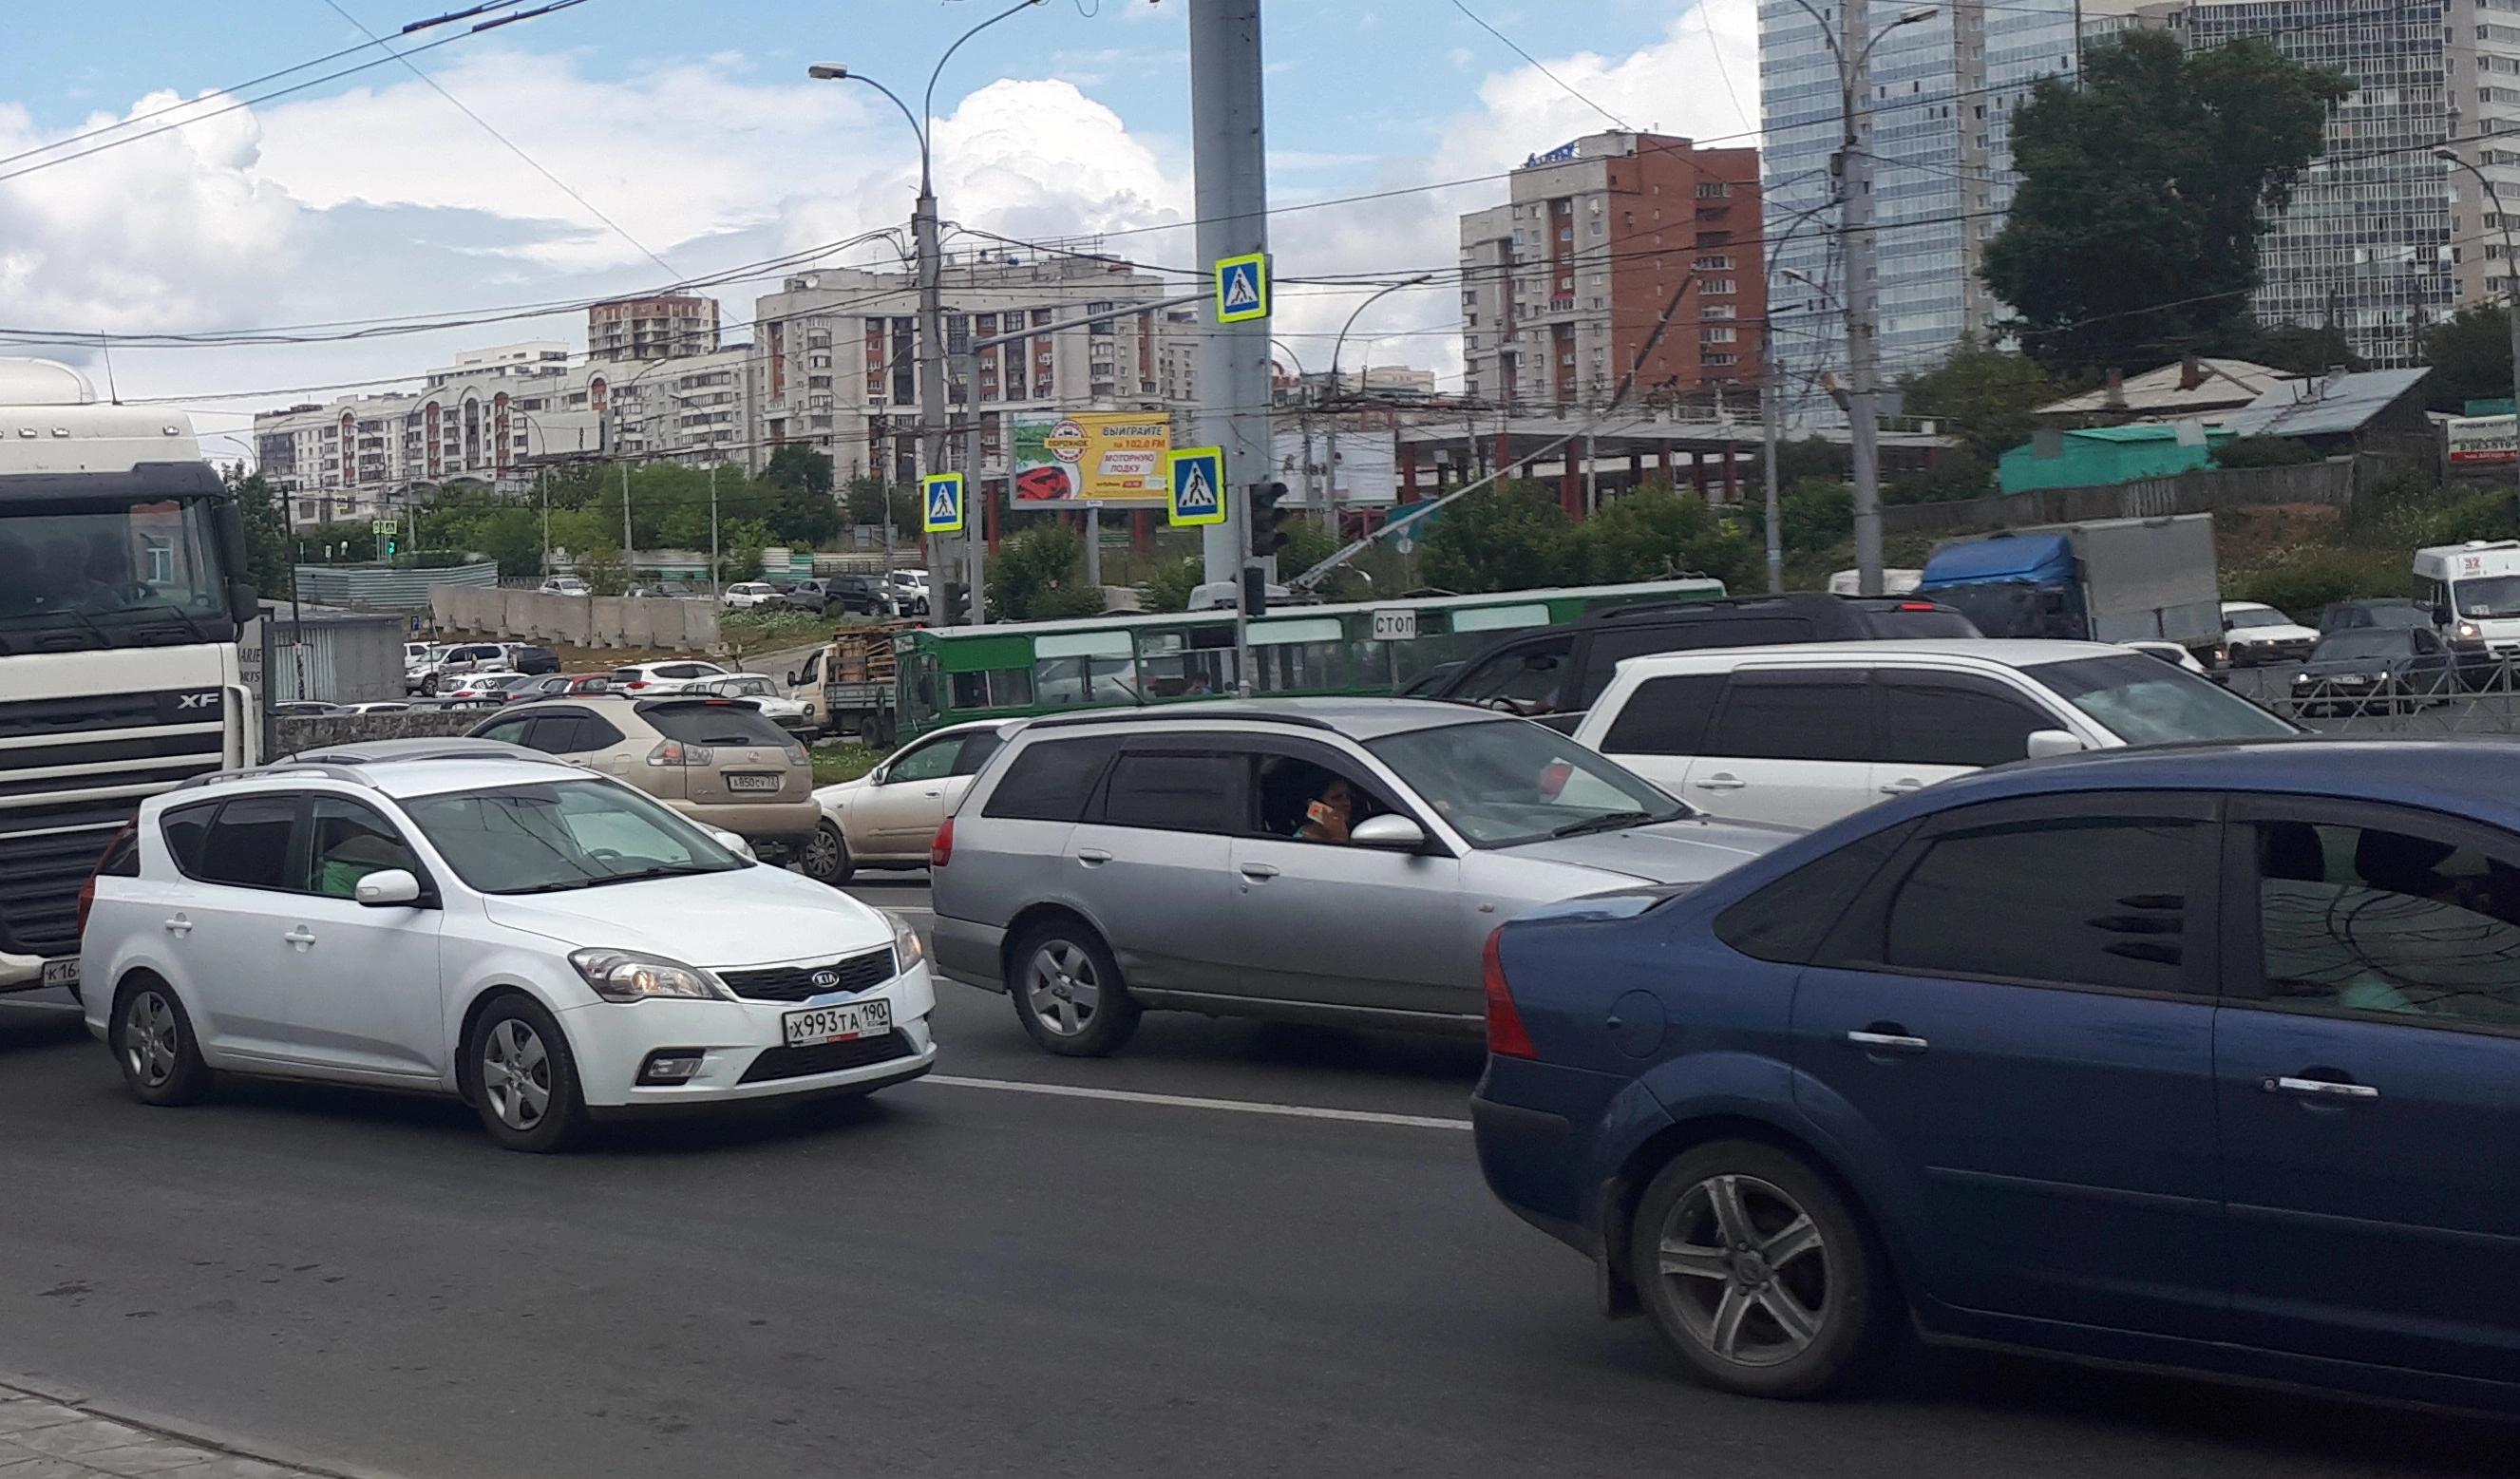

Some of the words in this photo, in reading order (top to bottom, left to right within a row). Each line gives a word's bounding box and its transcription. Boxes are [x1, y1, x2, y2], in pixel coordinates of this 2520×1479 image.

[1102, 426, 1163, 437] ВЫИГРАЙТЕ
[1151, 439, 1165, 448] FM
[1104, 453, 1155, 463] МОТОРНУЮ
[1109, 464, 1141, 473] ЛОДКУ
[1375, 616, 1413, 633] СТОП
[177, 692, 219, 710] XF
[48, 962, 80, 980] К16
[816, 973, 836, 985] KIA
[862, 1002, 887, 1020] 190
